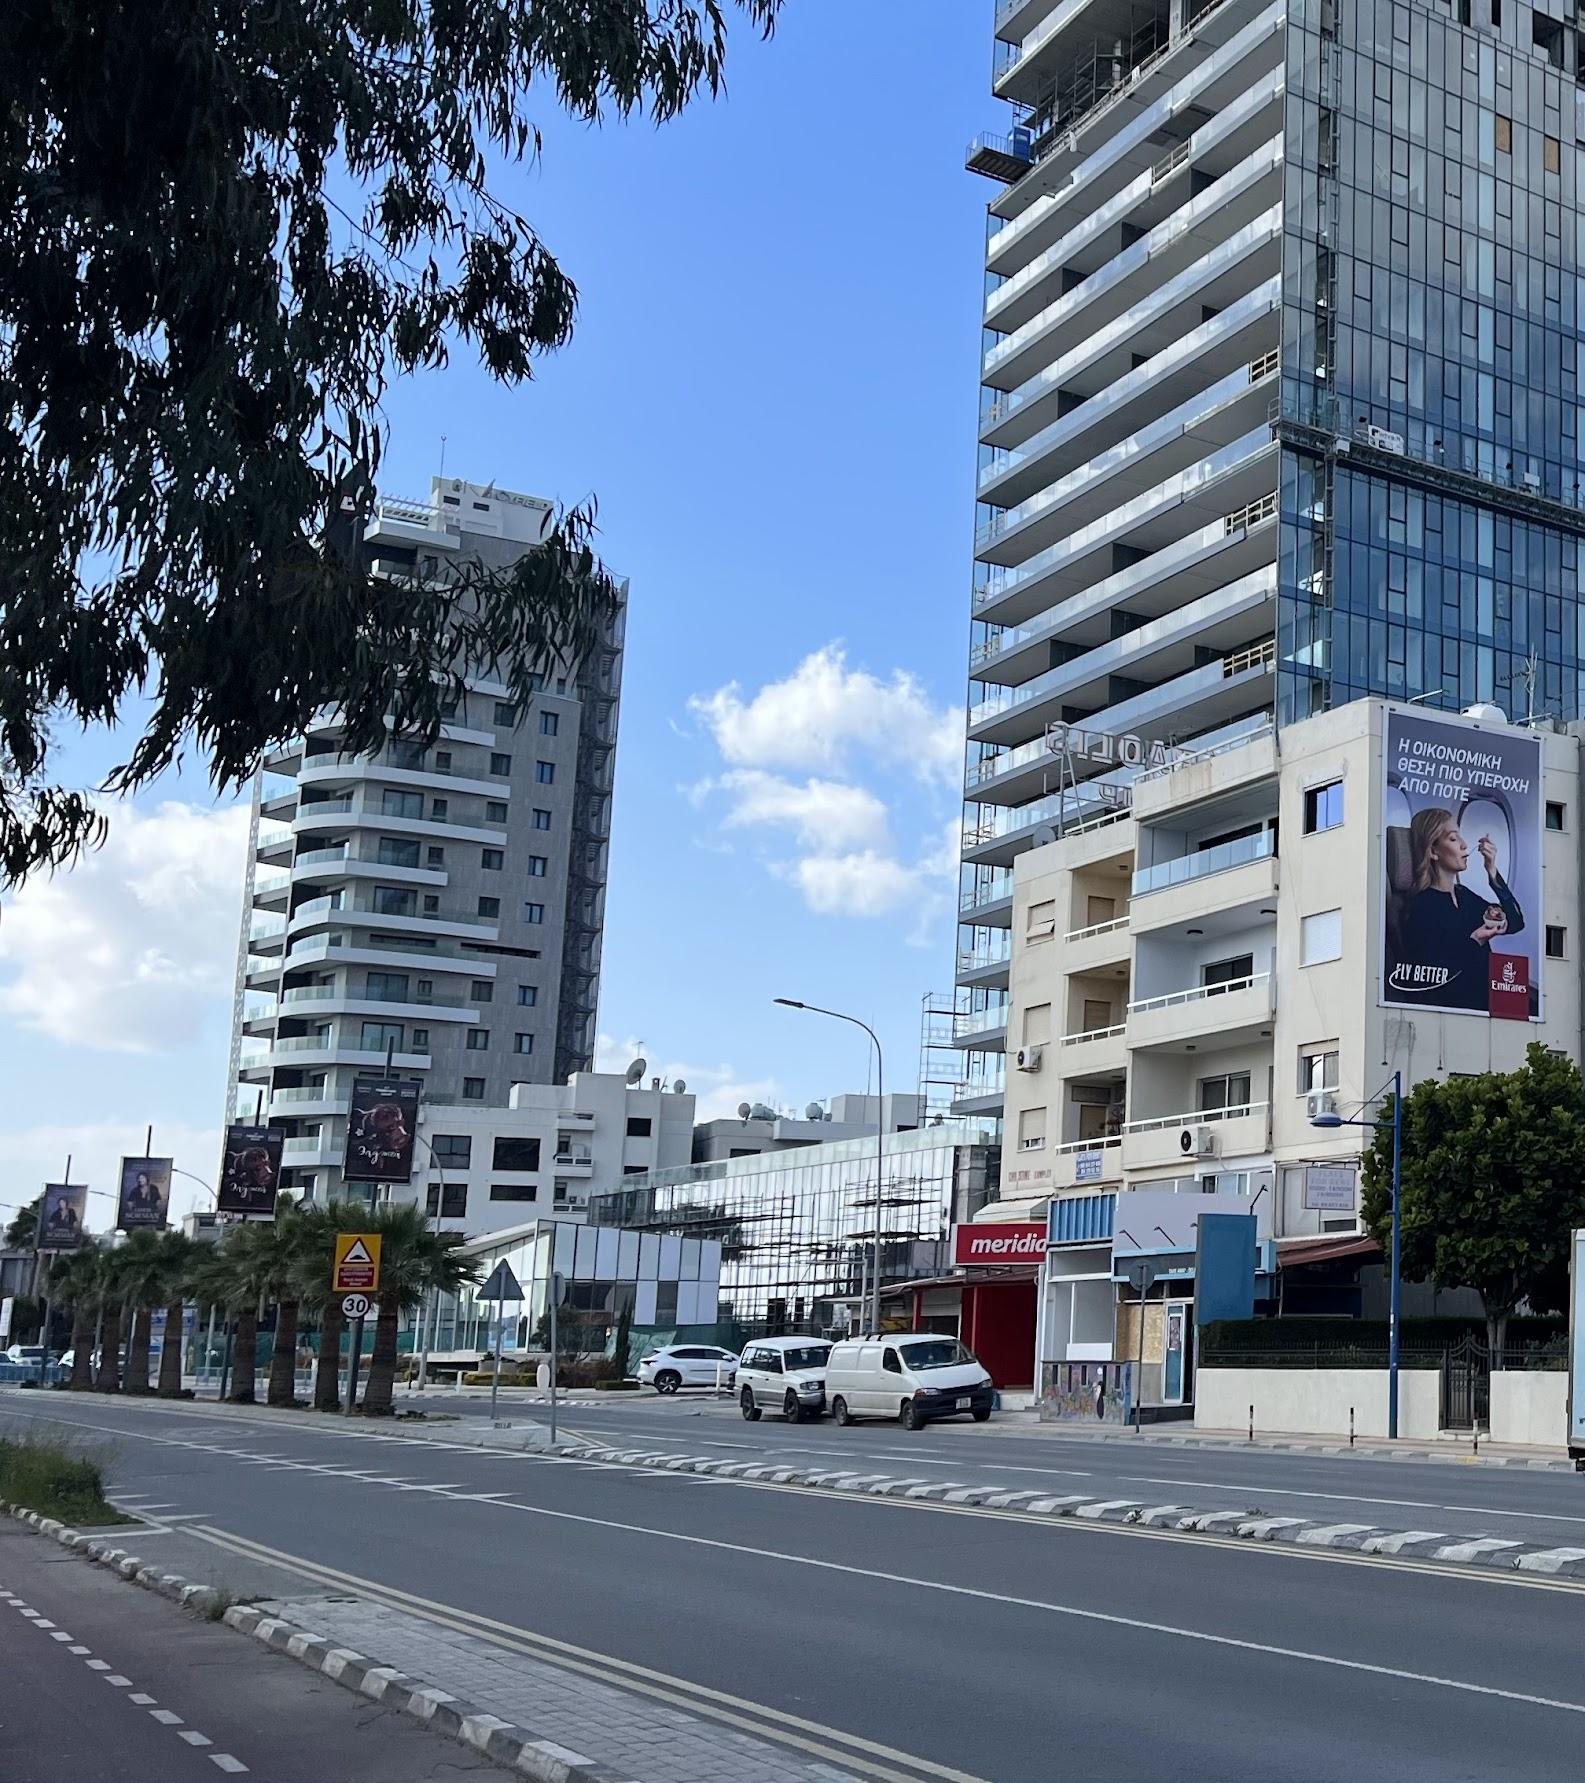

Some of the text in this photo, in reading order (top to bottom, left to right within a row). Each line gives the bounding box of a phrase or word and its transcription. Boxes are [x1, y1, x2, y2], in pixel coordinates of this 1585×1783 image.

[1398, 738, 1502, 771] Η ΟΙΚΟΝΟΜΙΚΗ
[1397, 757, 1530, 794] ΘΕΣΗ ΠΙΟ ΥΠΕΡΟΧΗ
[1398, 777, 1471, 802] ΑΠΟ ΠΟΤΕ
[1394, 963, 1449, 984] FLY BETTER
[1491, 979, 1527, 994] Emirates
[345, 1298, 366, 1313] 30
